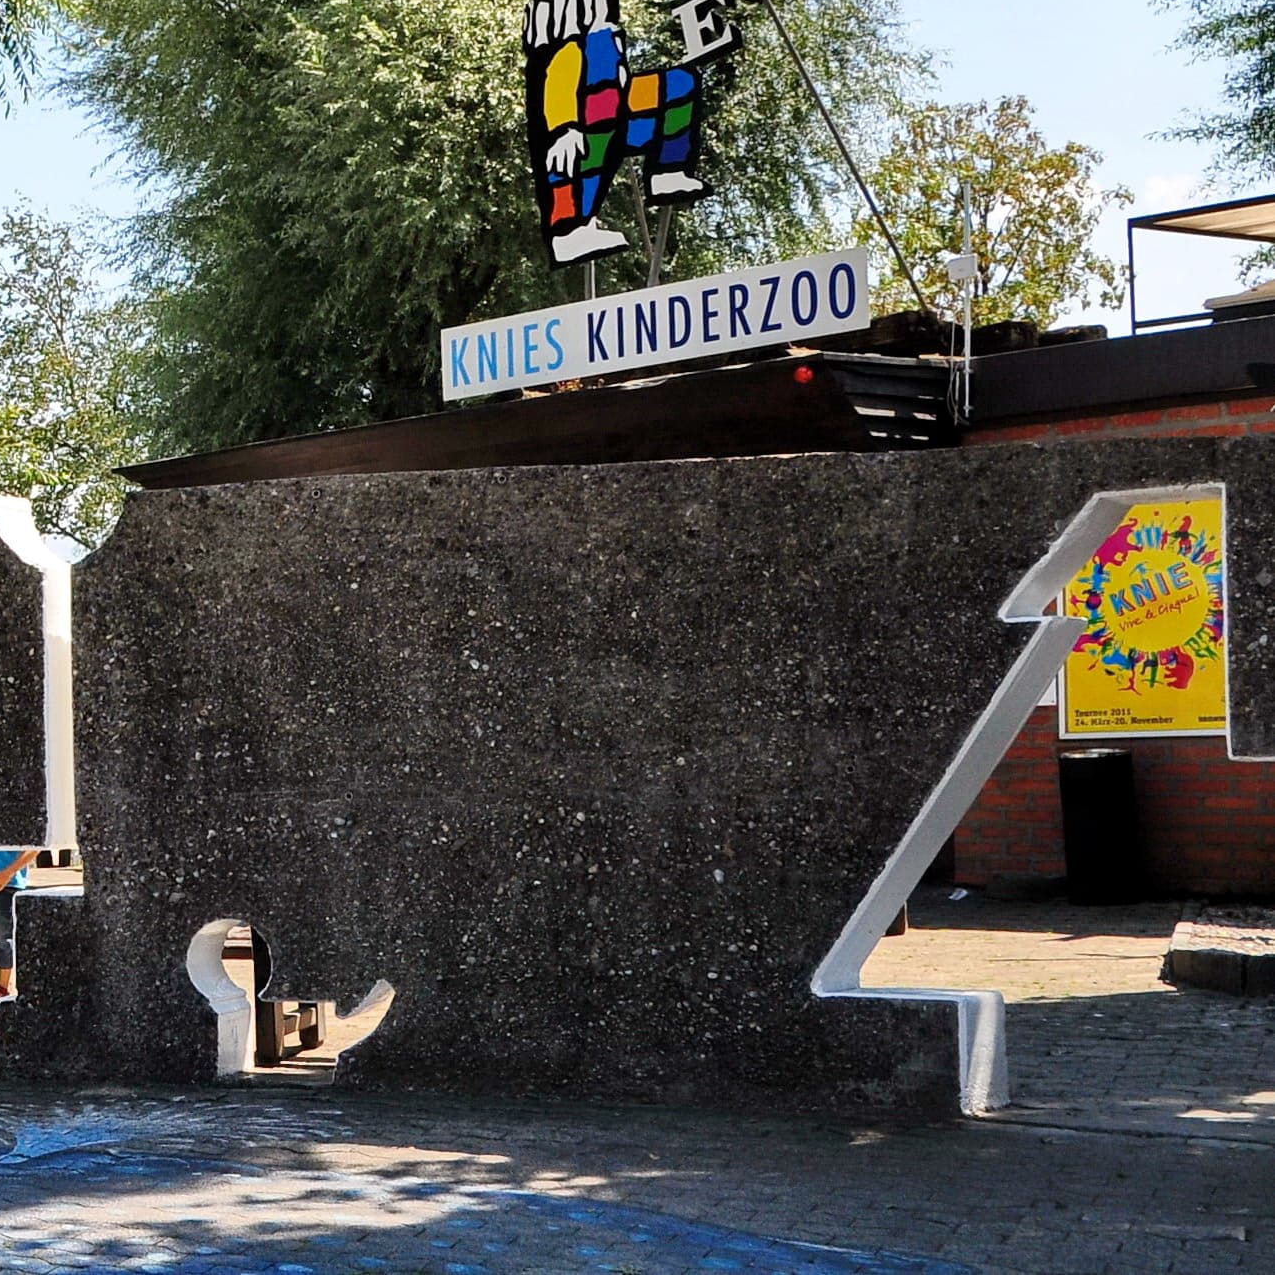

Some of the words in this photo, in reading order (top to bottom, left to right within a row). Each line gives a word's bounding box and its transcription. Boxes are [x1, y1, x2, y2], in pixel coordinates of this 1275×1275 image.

[451, 318, 566, 387] KNIES
[587, 263, 857, 363] KINDERZOO
[1109, 562, 1194, 616] KNIE
[1130, 716, 1174, 724] November
